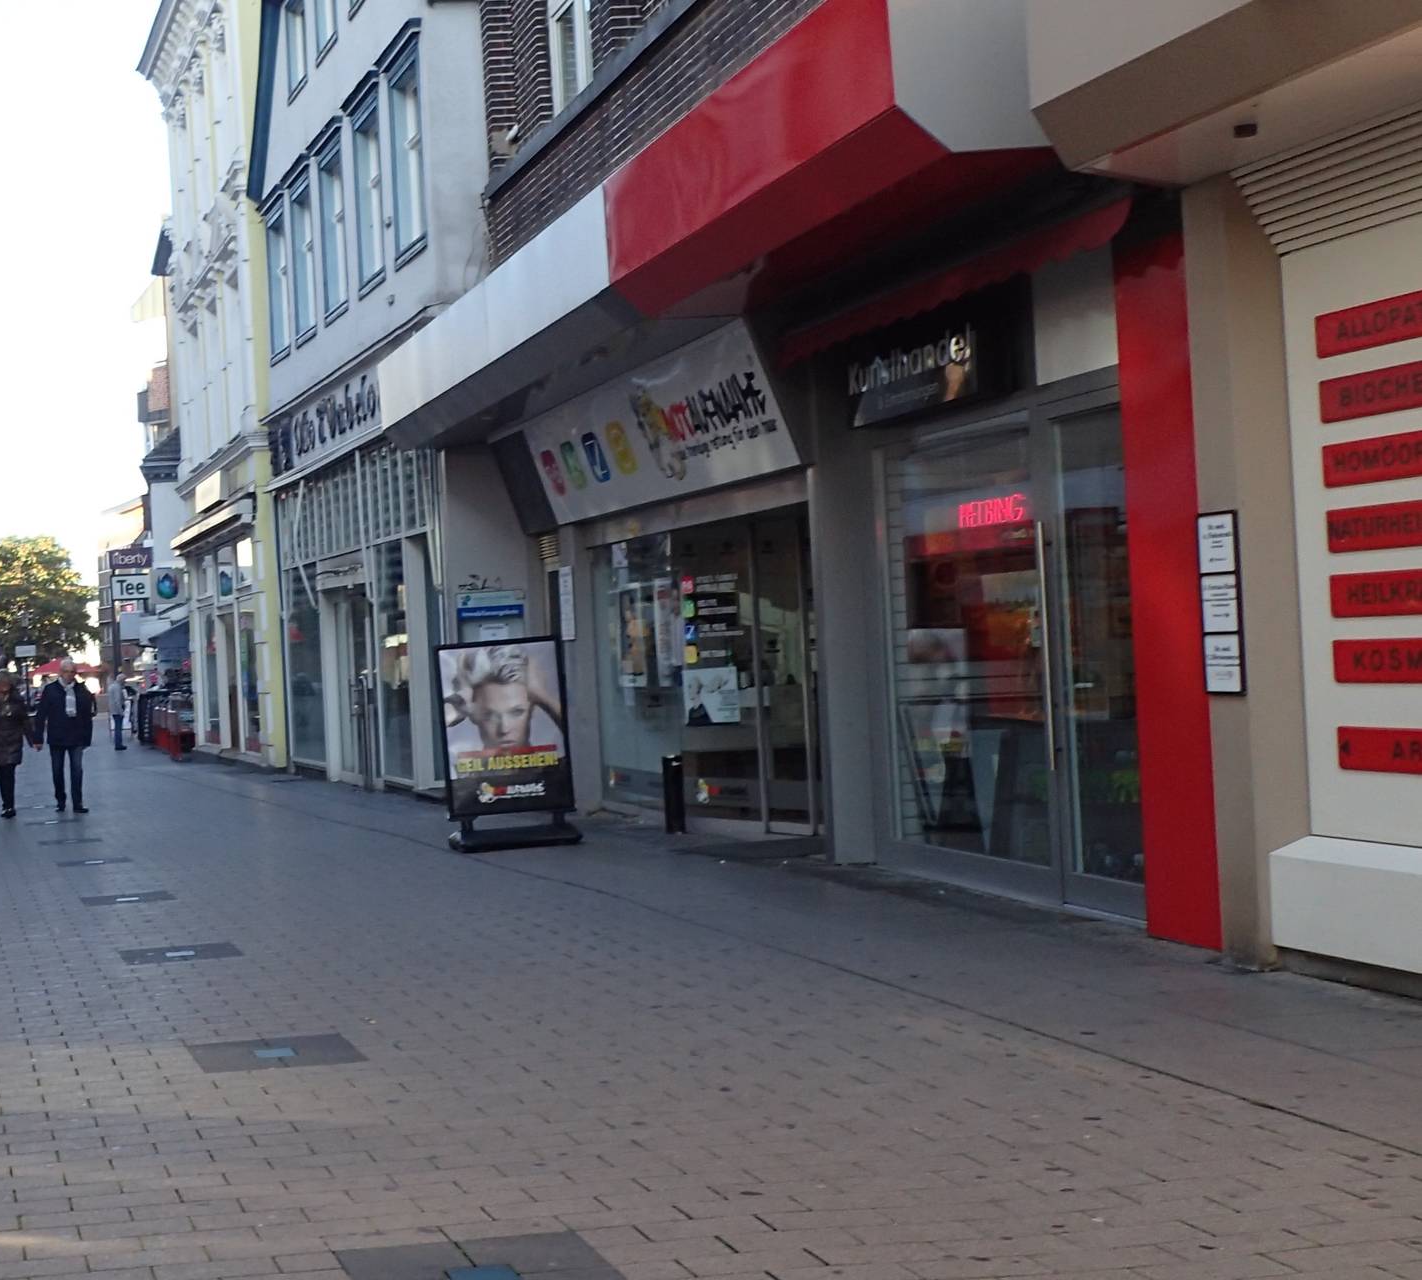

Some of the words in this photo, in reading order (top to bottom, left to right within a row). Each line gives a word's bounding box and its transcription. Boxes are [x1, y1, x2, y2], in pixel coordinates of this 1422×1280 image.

[847, 321, 972, 397] Kunsthandel
[117, 579, 146, 596] Tee
[487, 751, 559, 771] AUSSEHEN!
